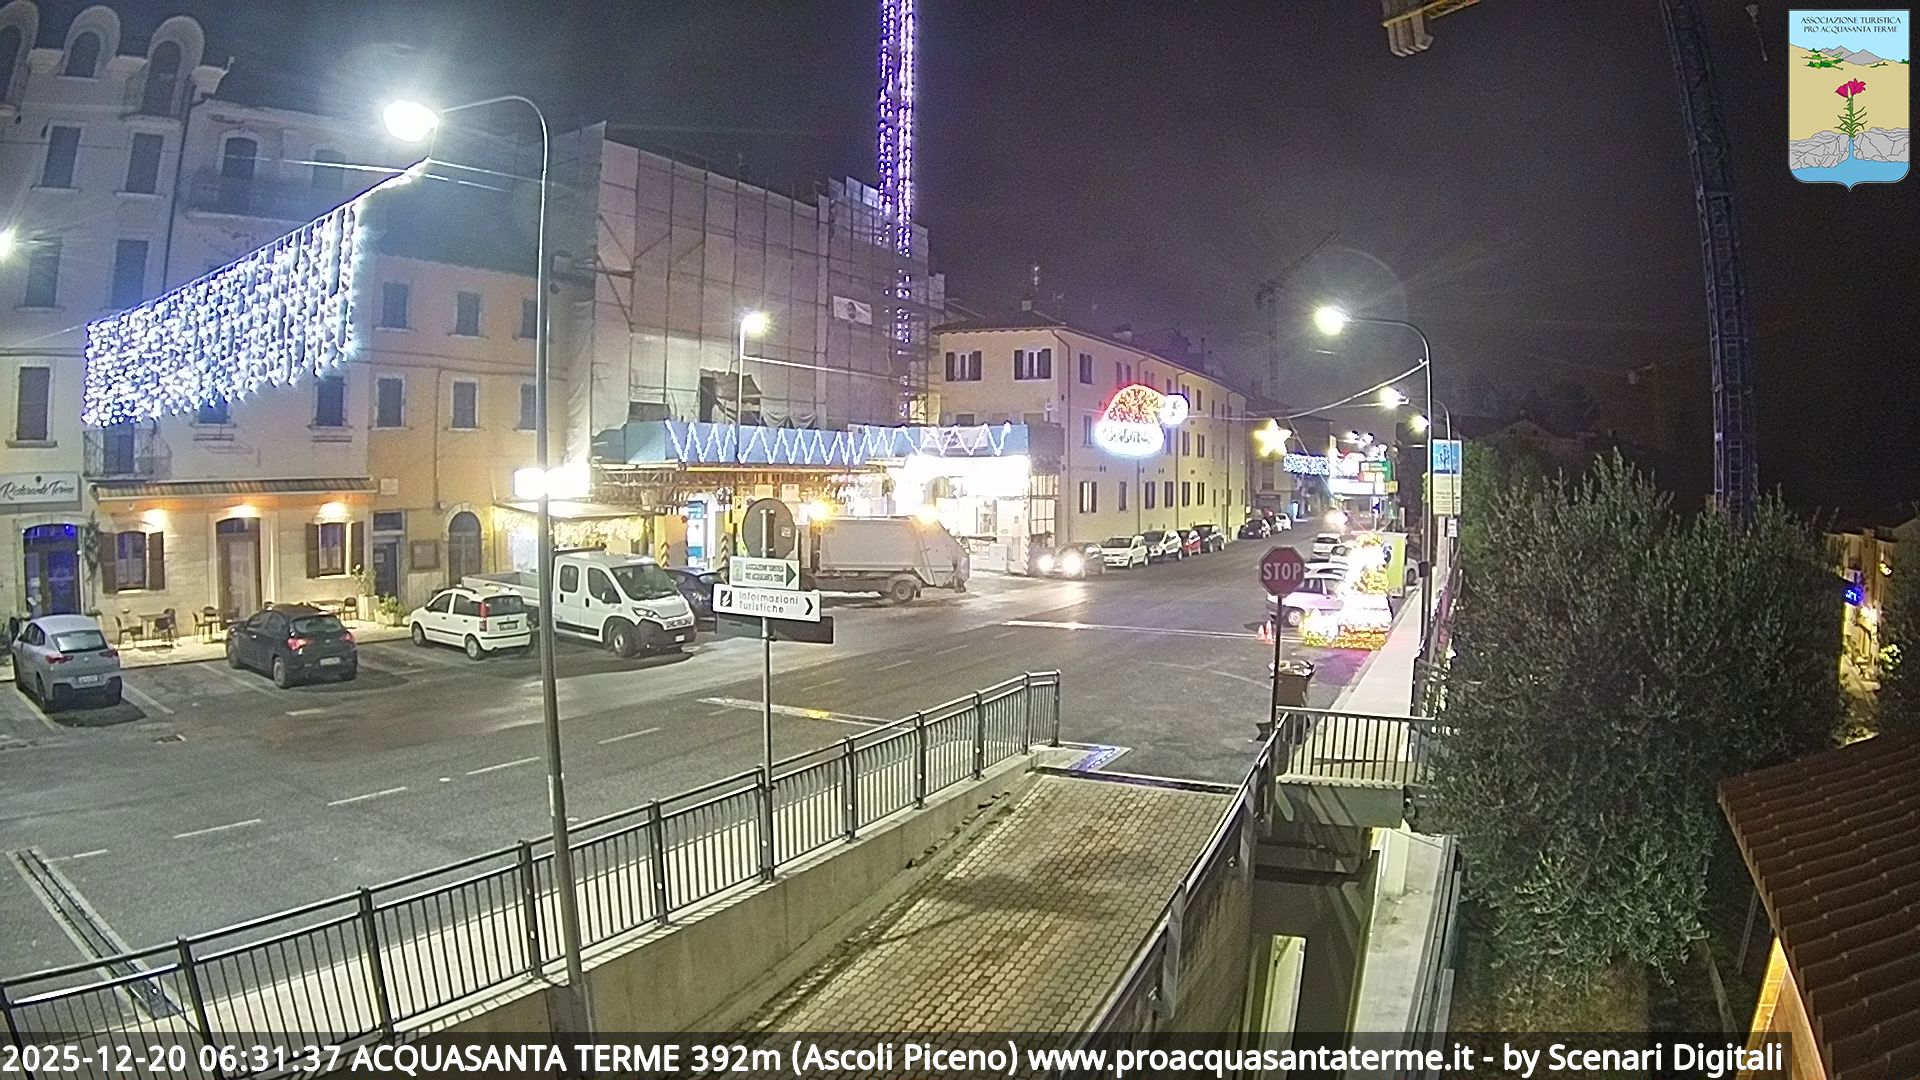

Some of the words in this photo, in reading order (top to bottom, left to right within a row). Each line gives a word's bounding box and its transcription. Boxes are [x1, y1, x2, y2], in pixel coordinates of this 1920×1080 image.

[1263, 562, 1302, 581] STOP
[738, 591, 799, 605] Informazioni
[738, 601, 784, 613] Turistiche
